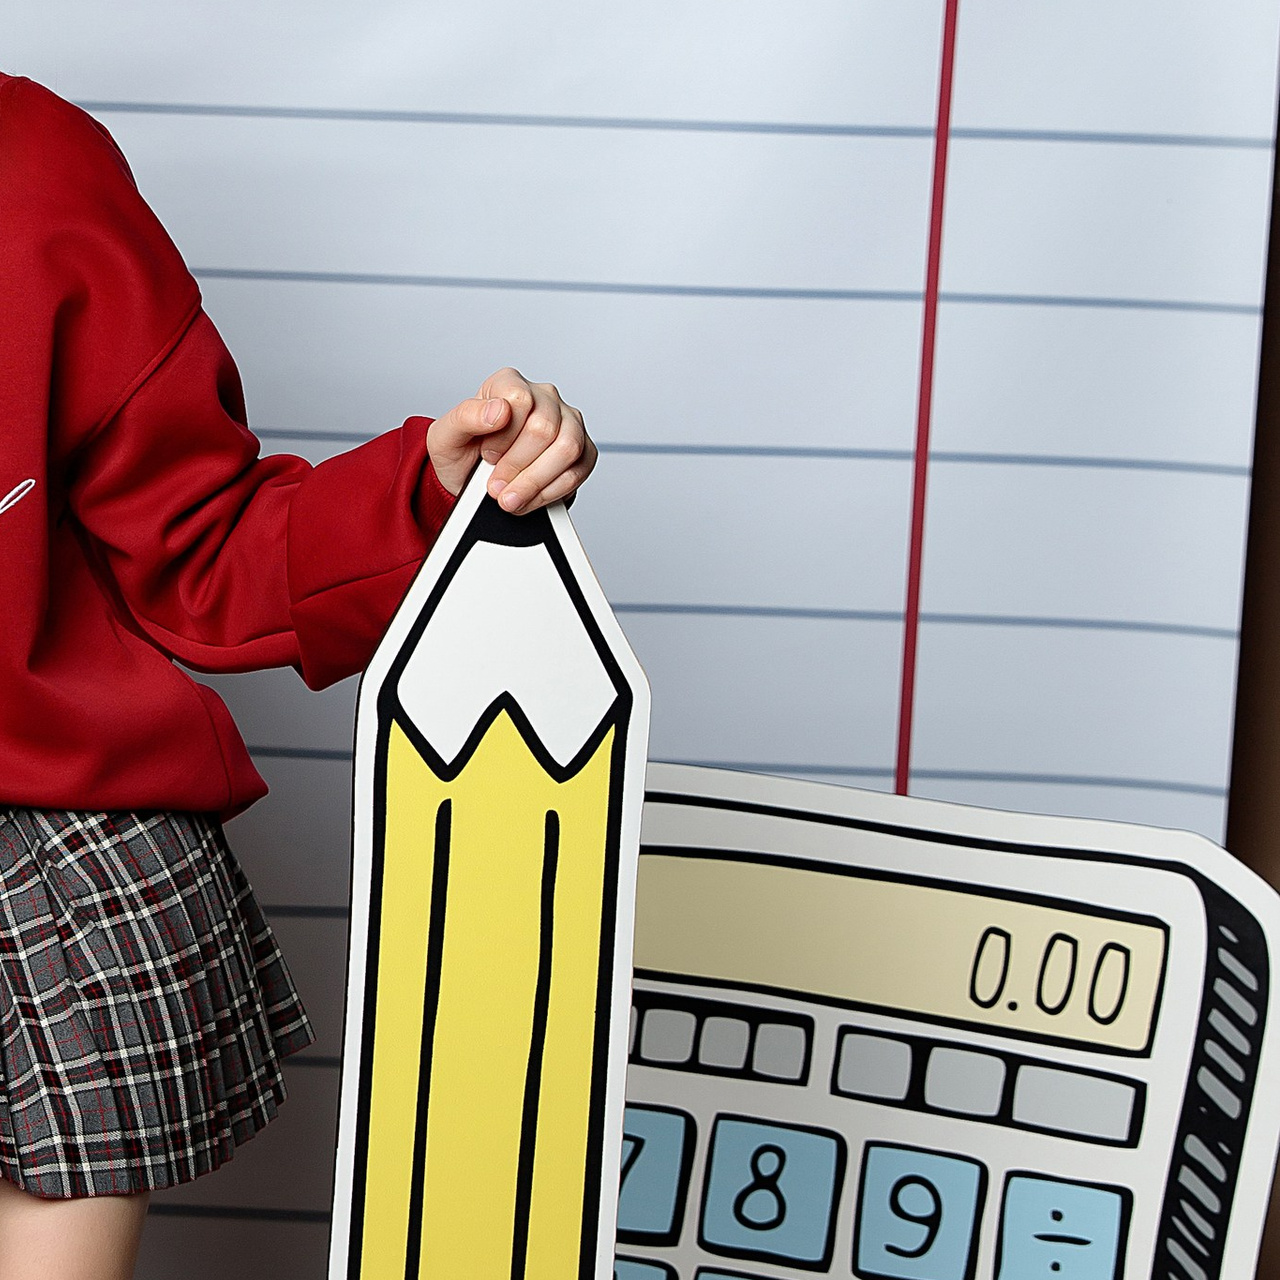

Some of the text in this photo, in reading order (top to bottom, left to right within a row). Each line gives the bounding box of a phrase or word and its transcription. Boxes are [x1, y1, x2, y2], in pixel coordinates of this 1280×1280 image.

[969, 926, 1132, 1026] 0.00
[732, 1143, 787, 1232] 8
[884, 1174, 943, 1259] 9
